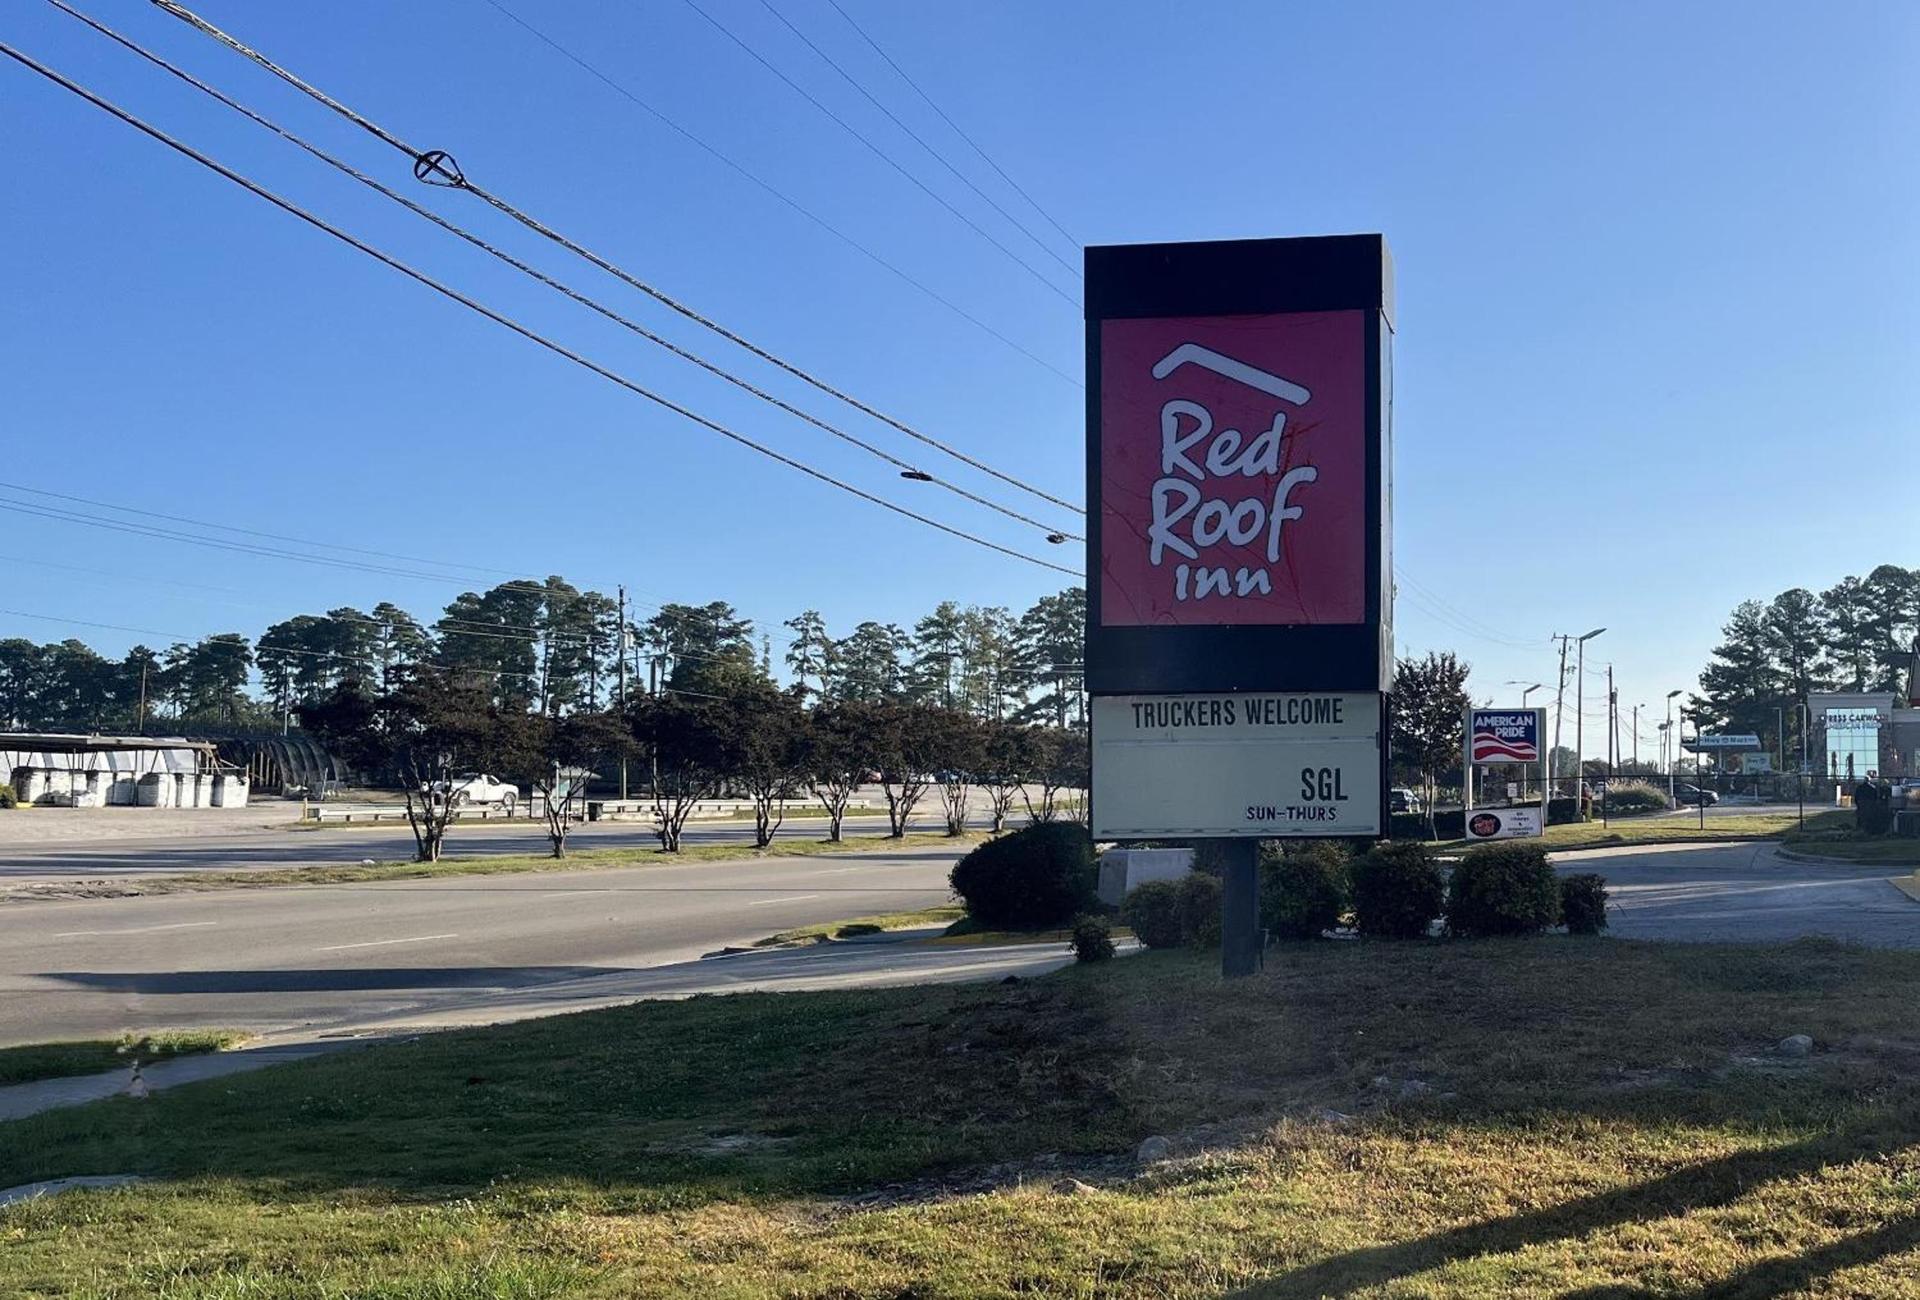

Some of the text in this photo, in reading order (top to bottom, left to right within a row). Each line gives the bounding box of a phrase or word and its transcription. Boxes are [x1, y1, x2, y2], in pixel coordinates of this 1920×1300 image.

[1161, 399, 1287, 481] Red
[1148, 465, 1317, 566] Roof
[1132, 698, 1343, 728] TRUCKERS WELCOME
[1475, 715, 1533, 727] AMERICAN
[1495, 727, 1525, 738] PRIDE
[1301, 767, 1348, 801] SGL
[1246, 806, 1337, 821] SUN-THURS
